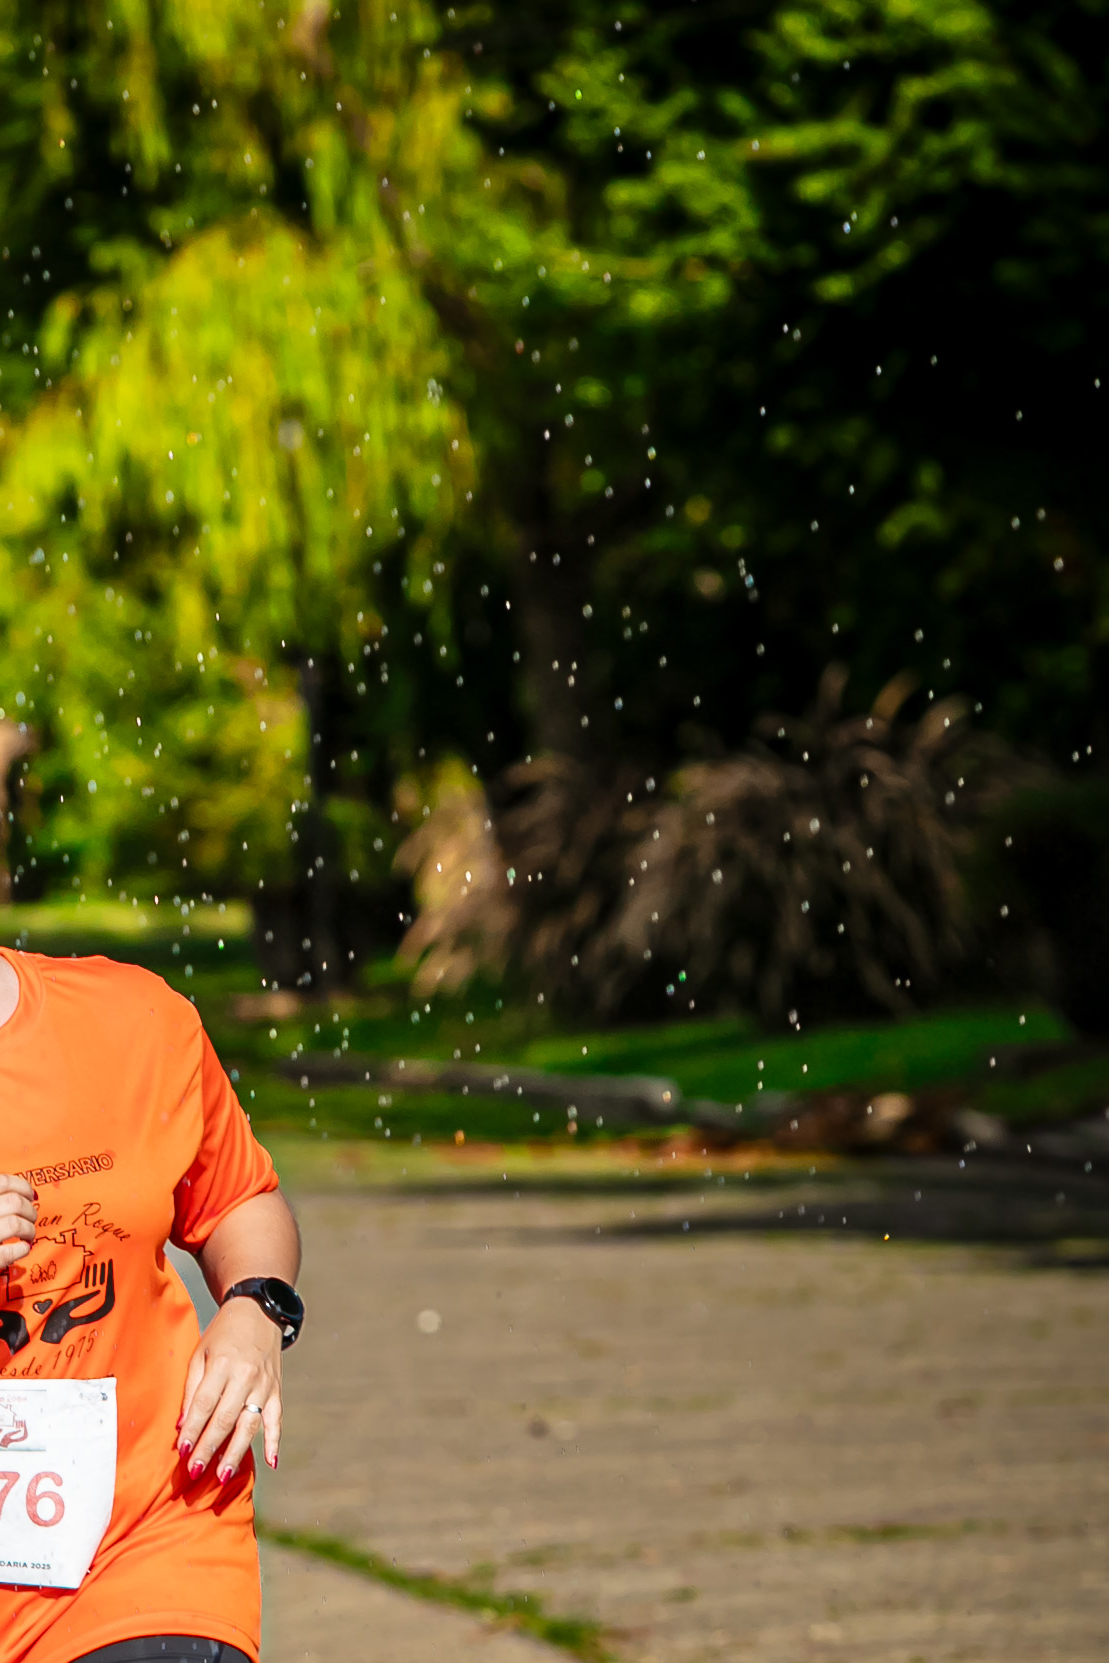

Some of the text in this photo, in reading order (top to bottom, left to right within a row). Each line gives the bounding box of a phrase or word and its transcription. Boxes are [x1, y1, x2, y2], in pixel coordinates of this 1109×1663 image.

[13, 1153, 114, 1188] VERSARIO
[71, 1201, 132, 1242] Roque
[52, 1328, 97, 1370] 1975
[30, 1562, 52, 1571] 2025
